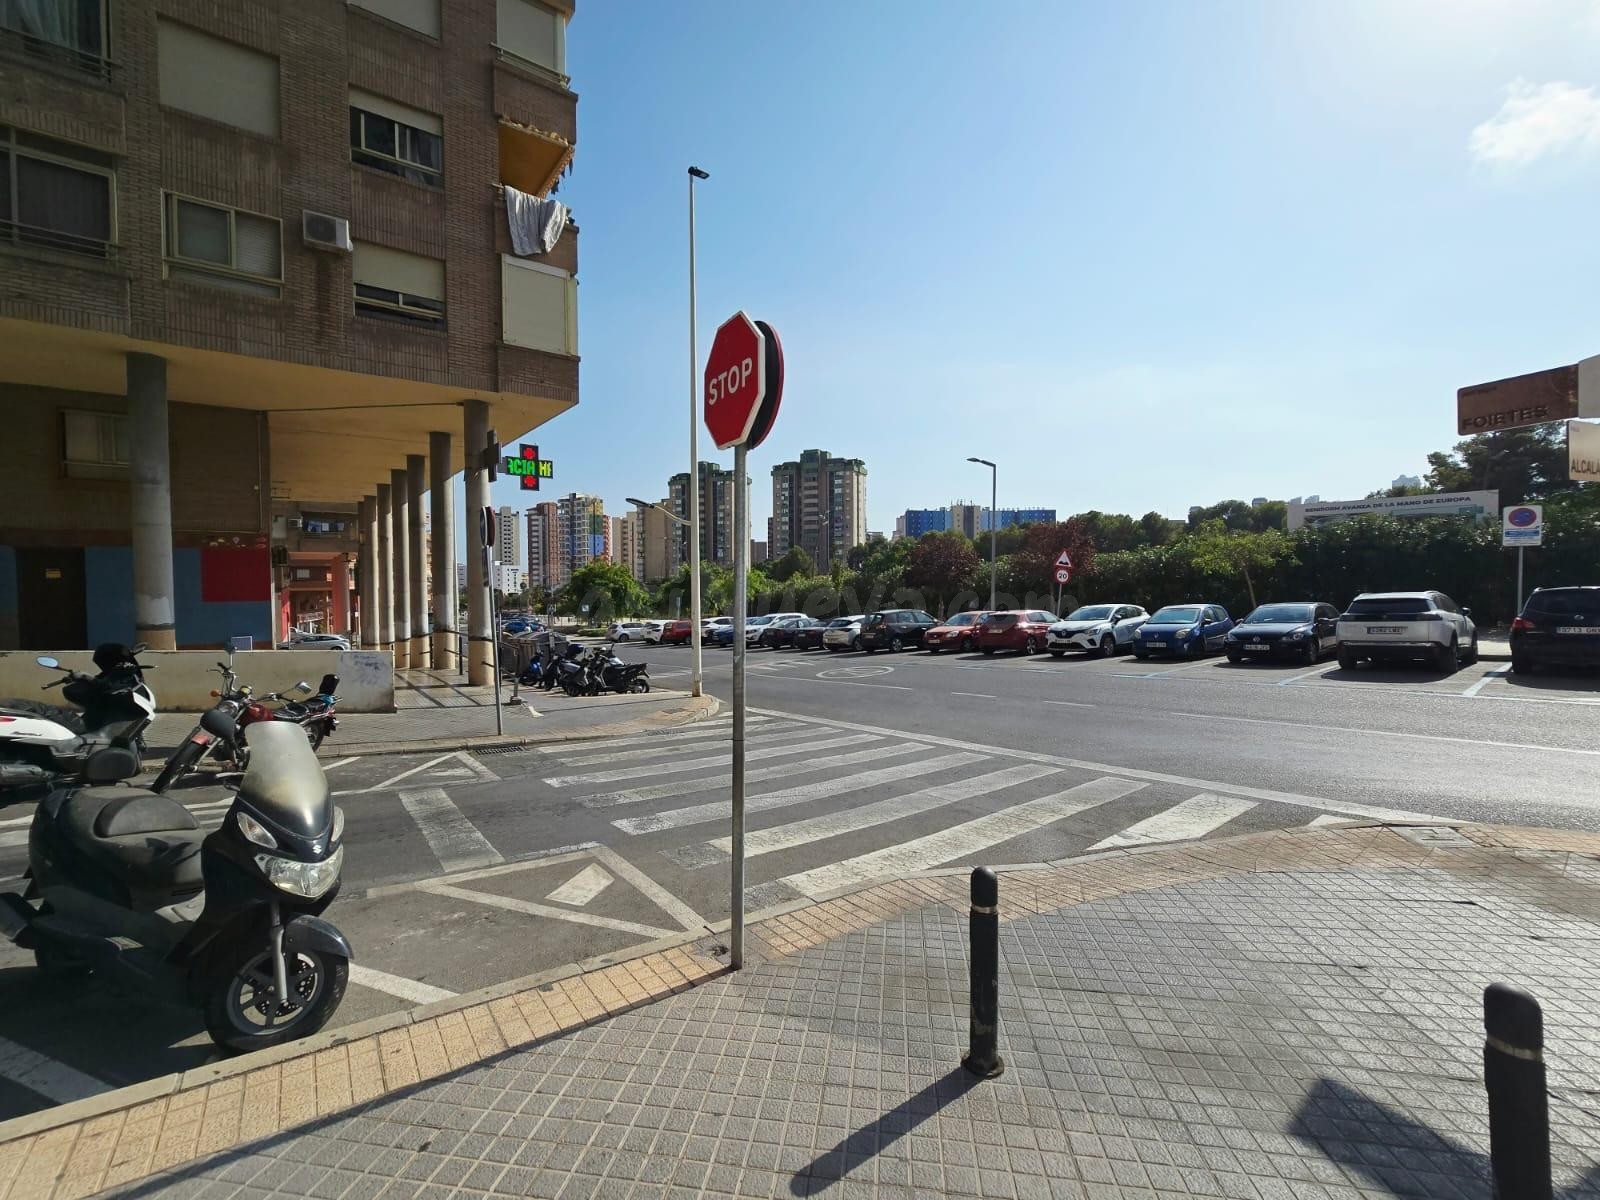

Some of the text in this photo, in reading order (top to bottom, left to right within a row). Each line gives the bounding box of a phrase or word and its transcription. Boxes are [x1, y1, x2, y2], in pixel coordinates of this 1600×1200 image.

[708, 357, 753, 406] STOP
[1462, 405, 1550, 430] FOIETES
[1342, 503, 1370, 511] AVANZA
[1058, 572, 1068, 580] 20
